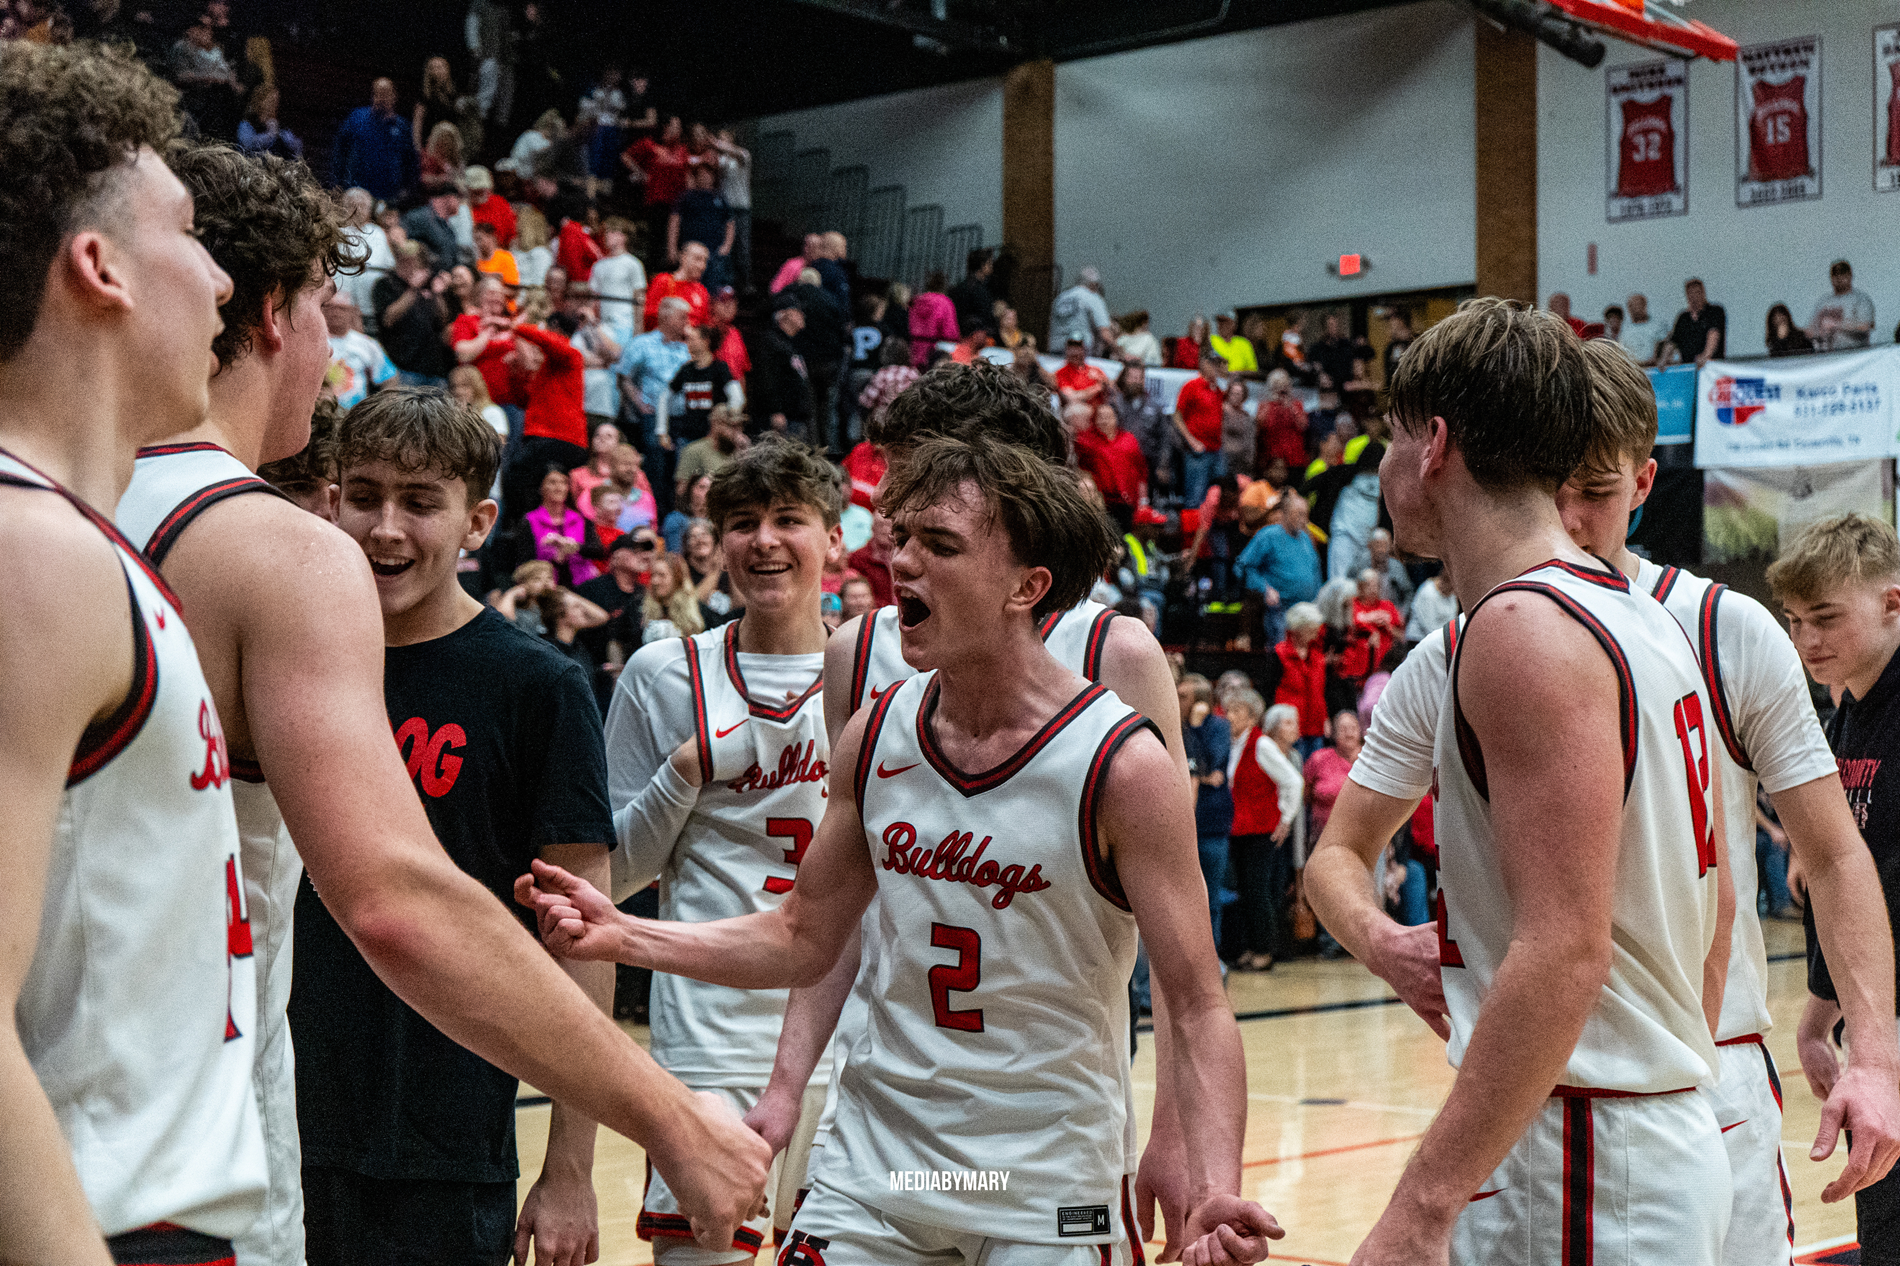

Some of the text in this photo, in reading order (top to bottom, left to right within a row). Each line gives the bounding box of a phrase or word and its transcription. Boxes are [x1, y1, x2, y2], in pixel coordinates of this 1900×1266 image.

[1632, 132, 1662, 162] 32
[1766, 115, 1791, 144] 15
[853, 326, 882, 360] P
[392, 716, 467, 798] OG
[763, 816, 814, 894] 3
[882, 821, 1052, 910] Bulldogs
[928, 921, 985, 1033] 2
[1097, 1214, 1105, 1226] M
